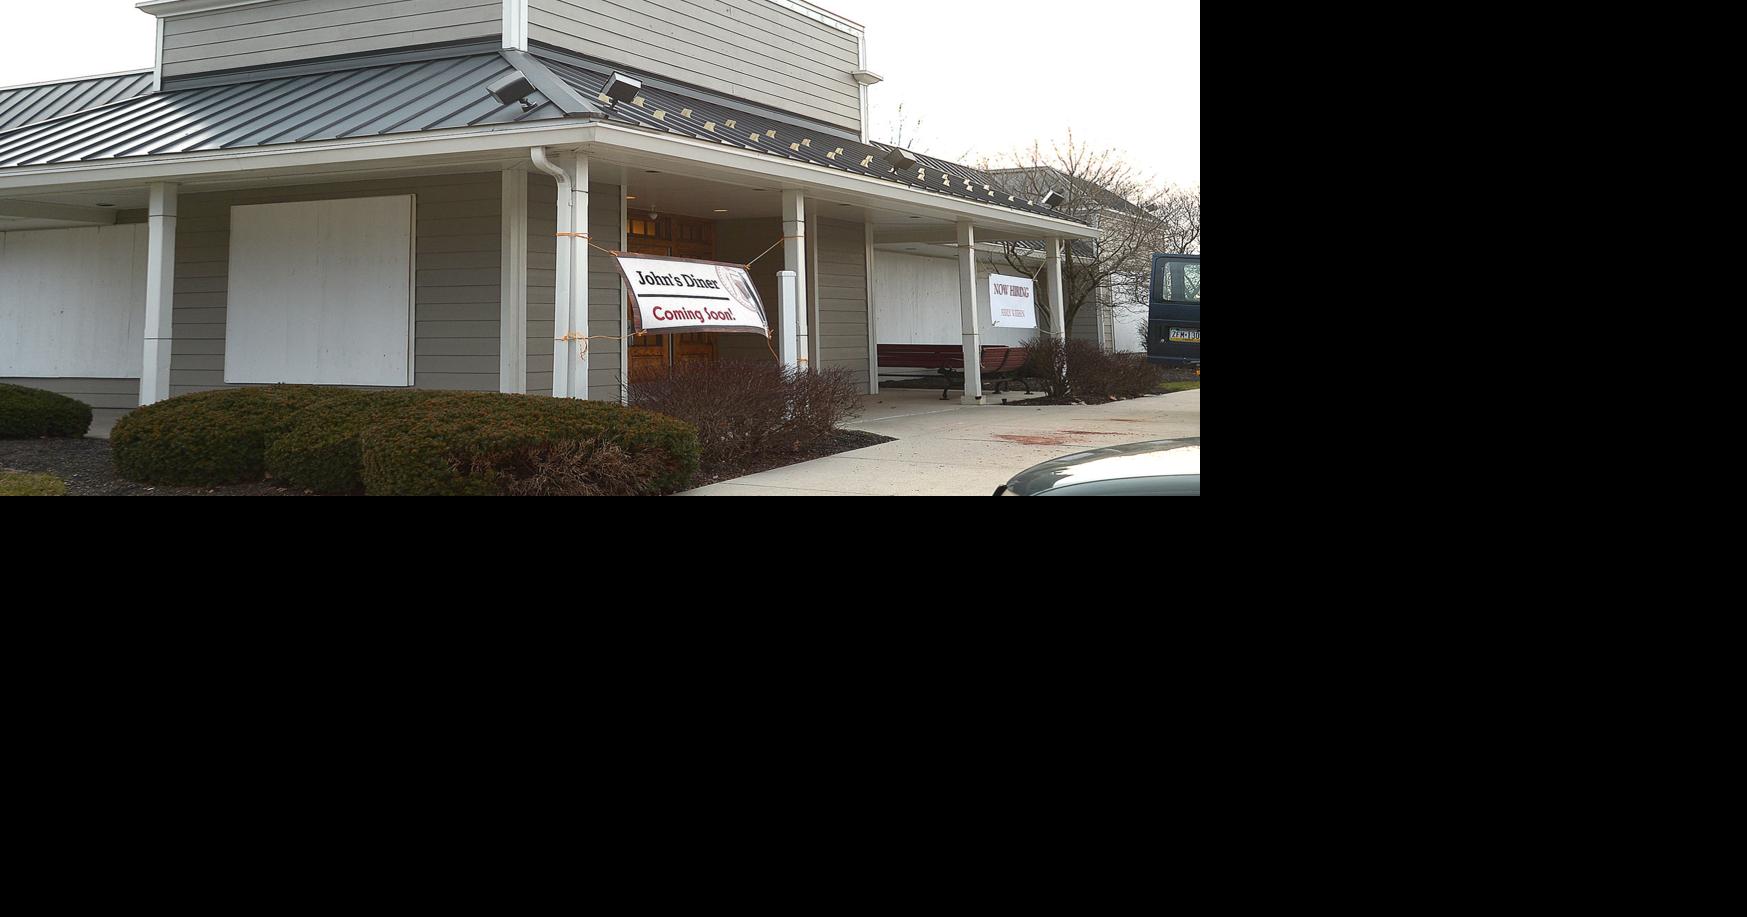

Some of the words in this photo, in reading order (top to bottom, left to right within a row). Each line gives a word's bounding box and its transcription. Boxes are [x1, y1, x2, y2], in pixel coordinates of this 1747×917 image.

[636, 270, 683, 287] John's
[681, 273, 720, 289] Diner
[993, 283, 1009, 295] NOW
[1009, 285, 1029, 298] HIRING
[653, 305, 704, 323] Coming
[703, 307, 736, 321] Soon!
